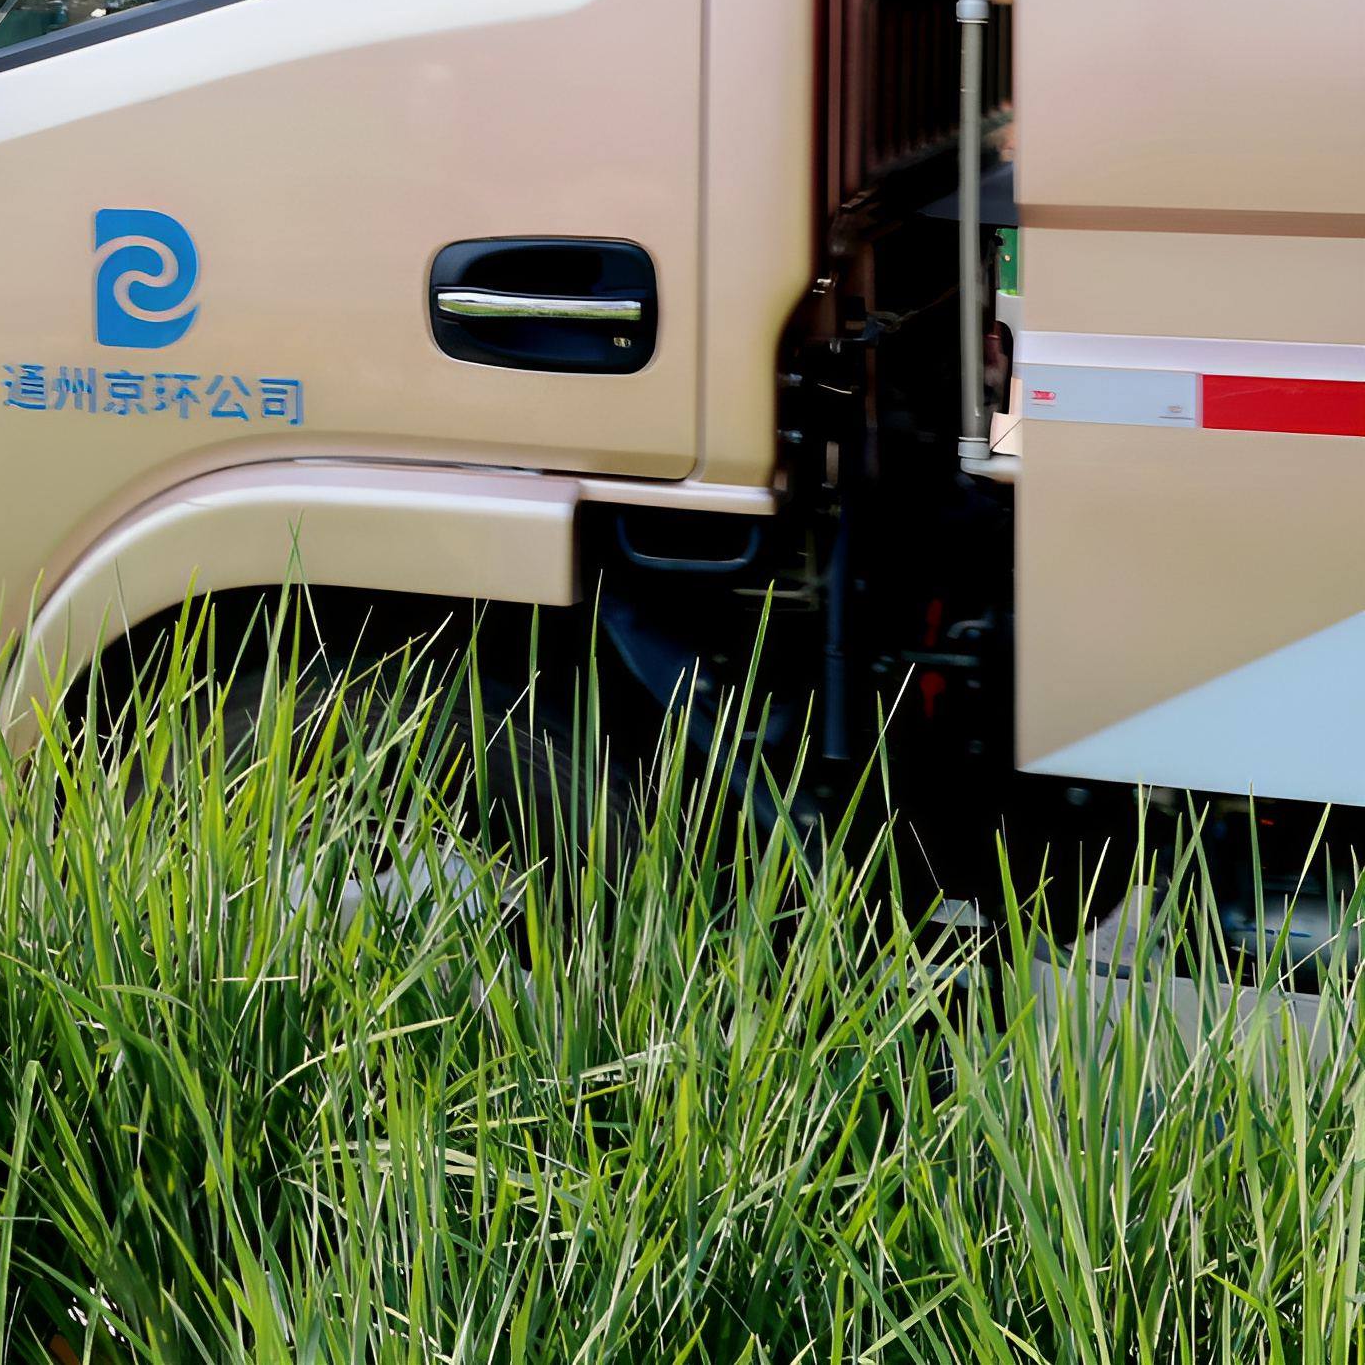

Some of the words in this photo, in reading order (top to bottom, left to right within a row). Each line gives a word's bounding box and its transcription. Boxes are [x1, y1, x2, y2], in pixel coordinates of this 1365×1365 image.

[2, 363, 305, 426] 通州京环公司
